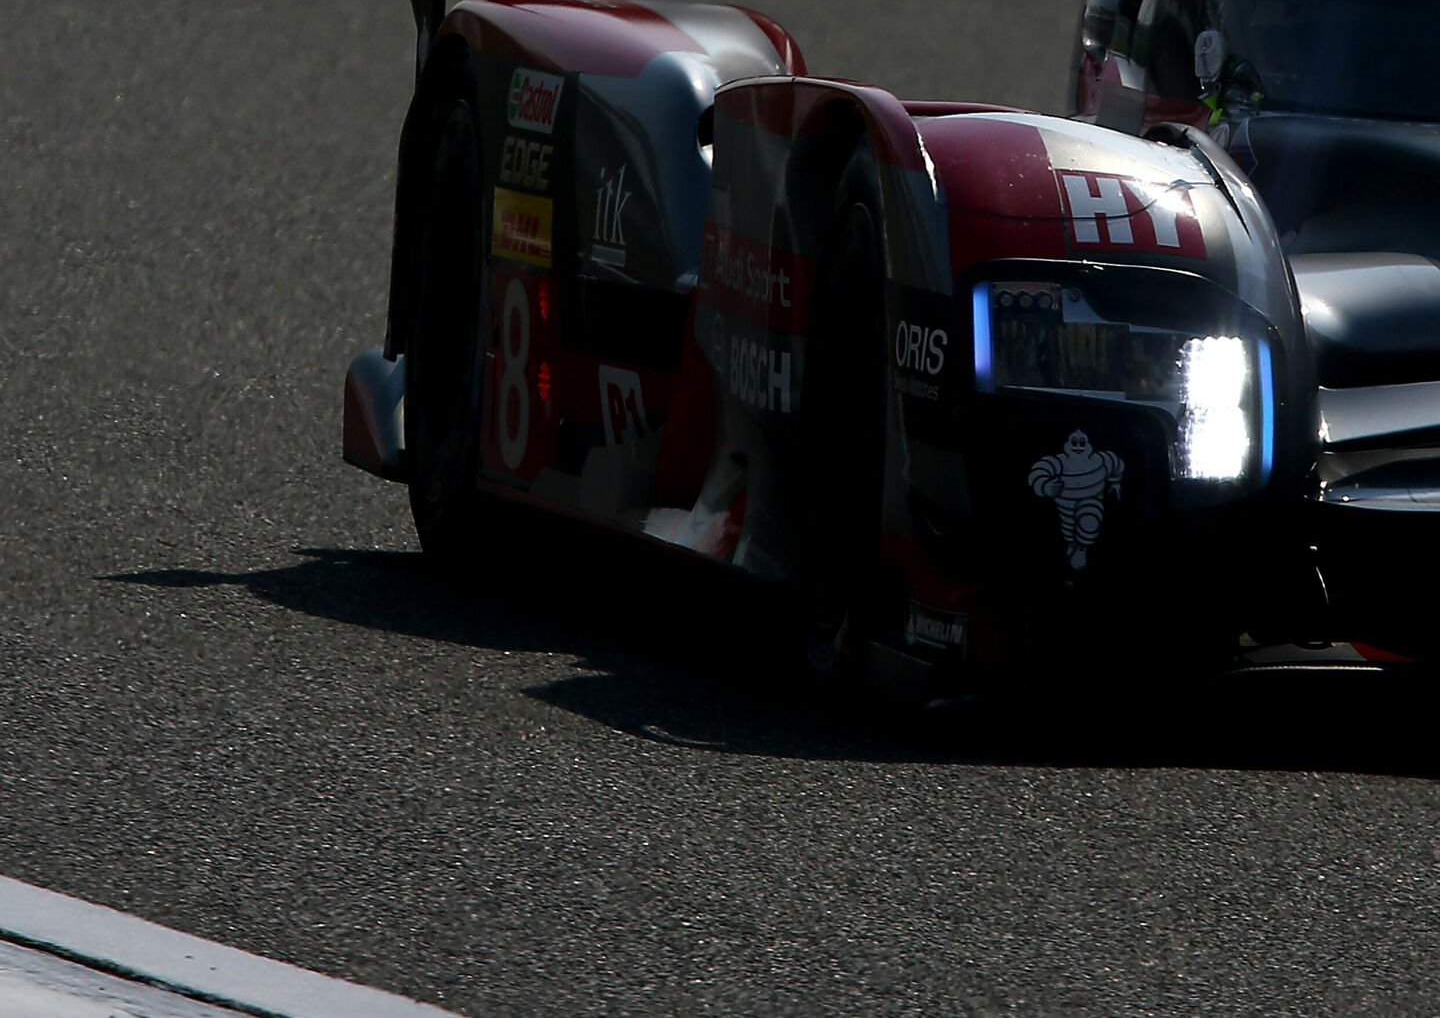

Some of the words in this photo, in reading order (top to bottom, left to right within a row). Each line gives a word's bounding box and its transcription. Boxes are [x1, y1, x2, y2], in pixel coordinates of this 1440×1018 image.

[518, 76, 560, 125] Castrol
[500, 135, 552, 191] EDGE
[592, 162, 632, 246] itk
[1062, 174, 1189, 248] HY
[715, 239, 744, 292] Audi
[746, 251, 793, 309] Sport
[500, 278, 531, 471] 8
[729, 334, 792, 414] BOSCH
[895, 320, 948, 375] ORIS
[606, 382, 646, 446] P1
